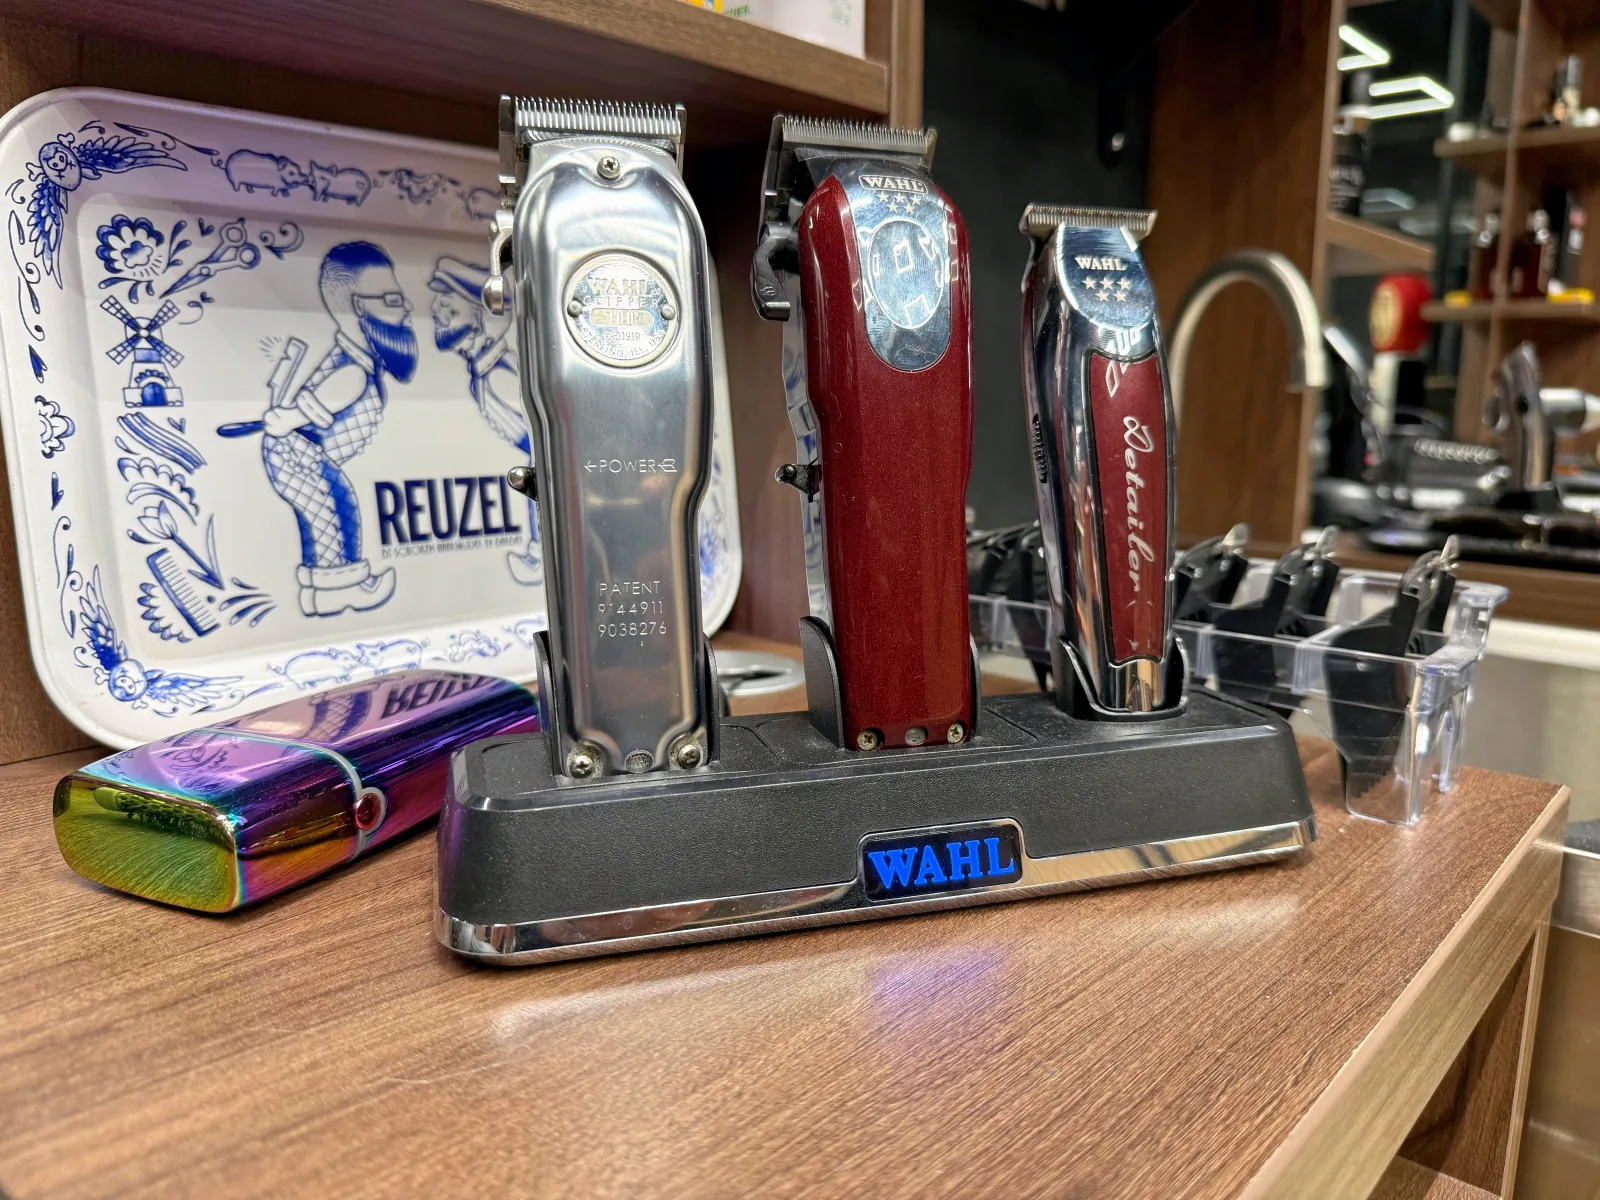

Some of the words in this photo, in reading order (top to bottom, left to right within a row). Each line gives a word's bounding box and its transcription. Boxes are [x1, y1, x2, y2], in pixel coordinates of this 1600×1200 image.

[862, 176, 925, 192] WAHL
[1075, 257, 1128, 271] WAHL
[588, 277, 653, 297] WAHL
[583, 296, 659, 308] CLIPPER
[599, 459, 656, 473] POWER
[374, 474, 522, 546] REUZEL
[1122, 415, 1156, 593] Detailer
[599, 580, 661, 596] PATENT
[598, 600, 664, 617] 9144911
[598, 621, 667, 638] 9038276
[868, 837, 1016, 890] WAHL
